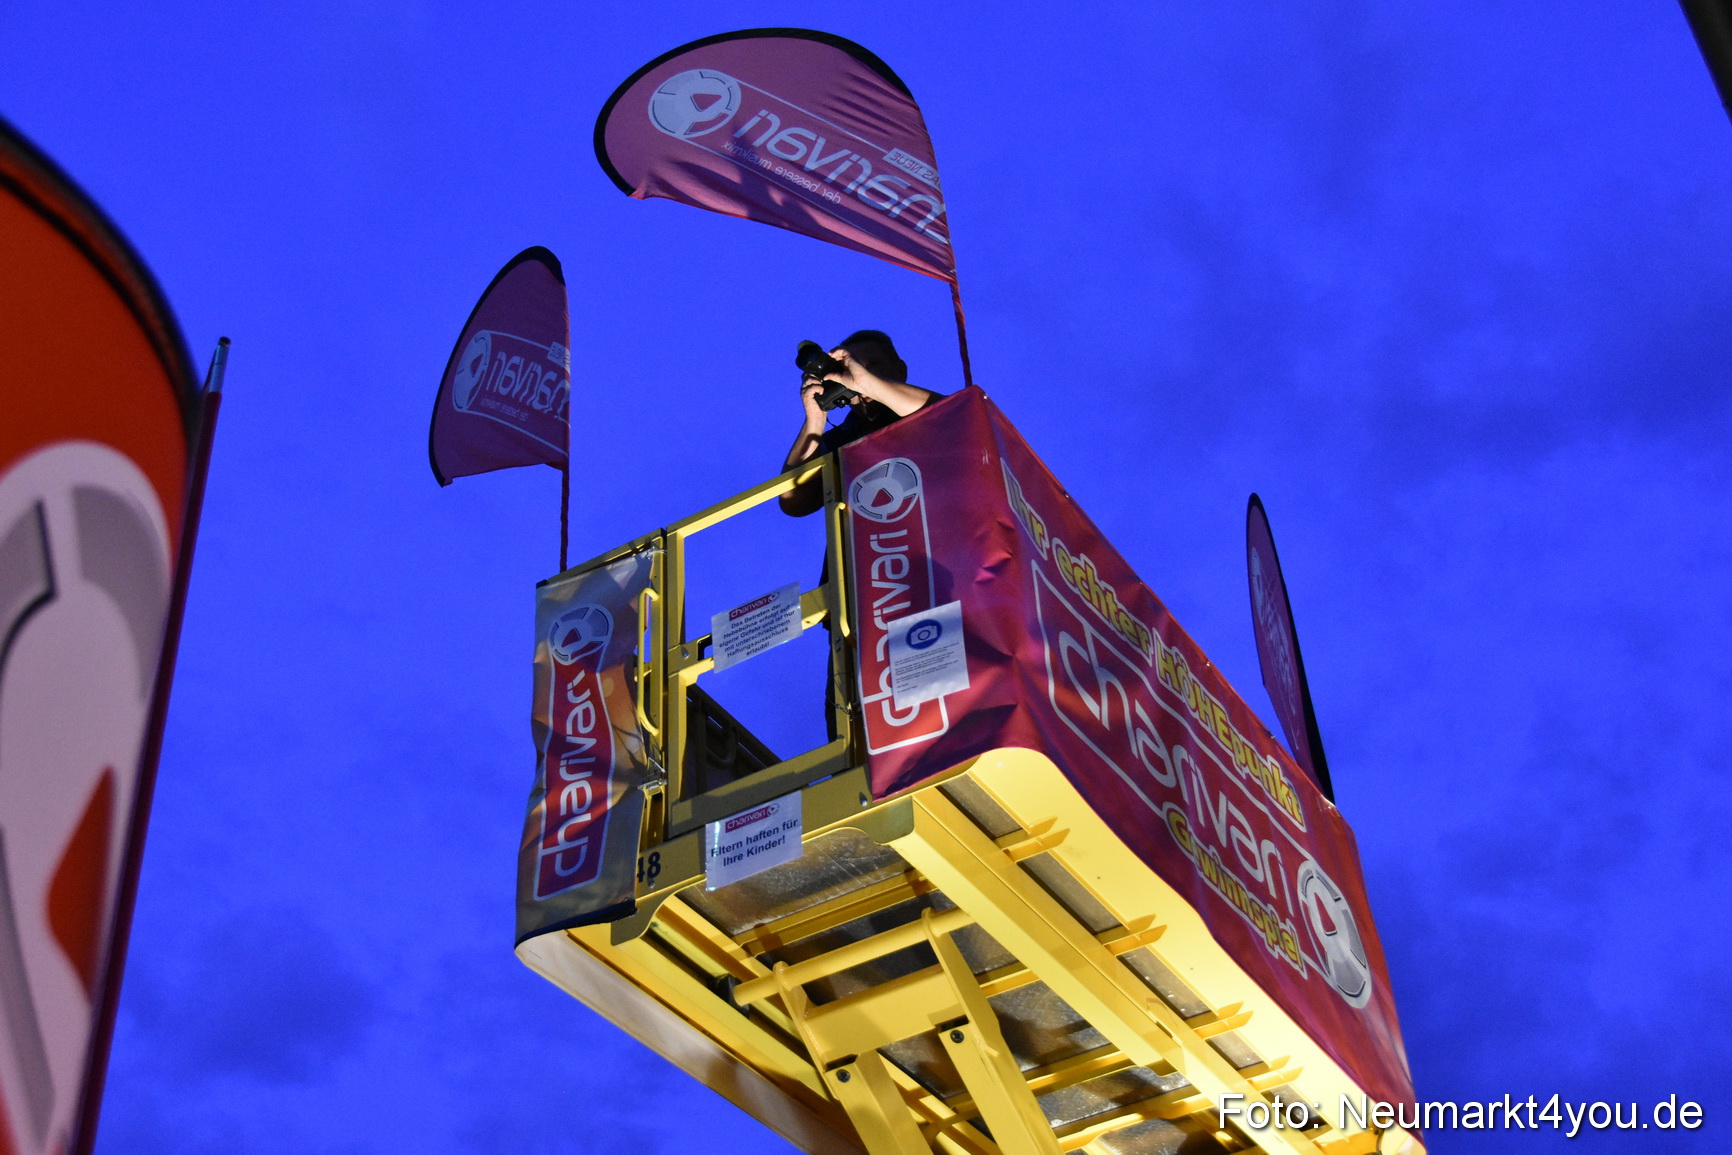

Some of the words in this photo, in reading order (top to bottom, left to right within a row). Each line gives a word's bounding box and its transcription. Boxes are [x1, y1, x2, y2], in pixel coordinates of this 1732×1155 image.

[719, 636, 739, 648] eigene
[740, 626, 761, 638] Gefahr
[762, 619, 774, 628] und
[784, 610, 795, 618] nur
[731, 621, 743, 629] Das
[744, 608, 770, 623] Betreten
[771, 603, 781, 611] der
[759, 610, 779, 624] erfolgt
[780, 605, 790, 613] auf
[724, 643, 735, 652] mit
[1055, 542, 1152, 661] echter
[1155, 633, 1304, 829] HÖHEpunkt
[543, 669, 597, 877] charivari
[1058, 622, 1294, 916] charivari
[711, 841, 743, 858] Eltern
[745, 826, 780, 845] haften
[782, 818, 799, 835] für
[723, 851, 744, 867] Ihre
[746, 835, 786, 857] Kinder!
